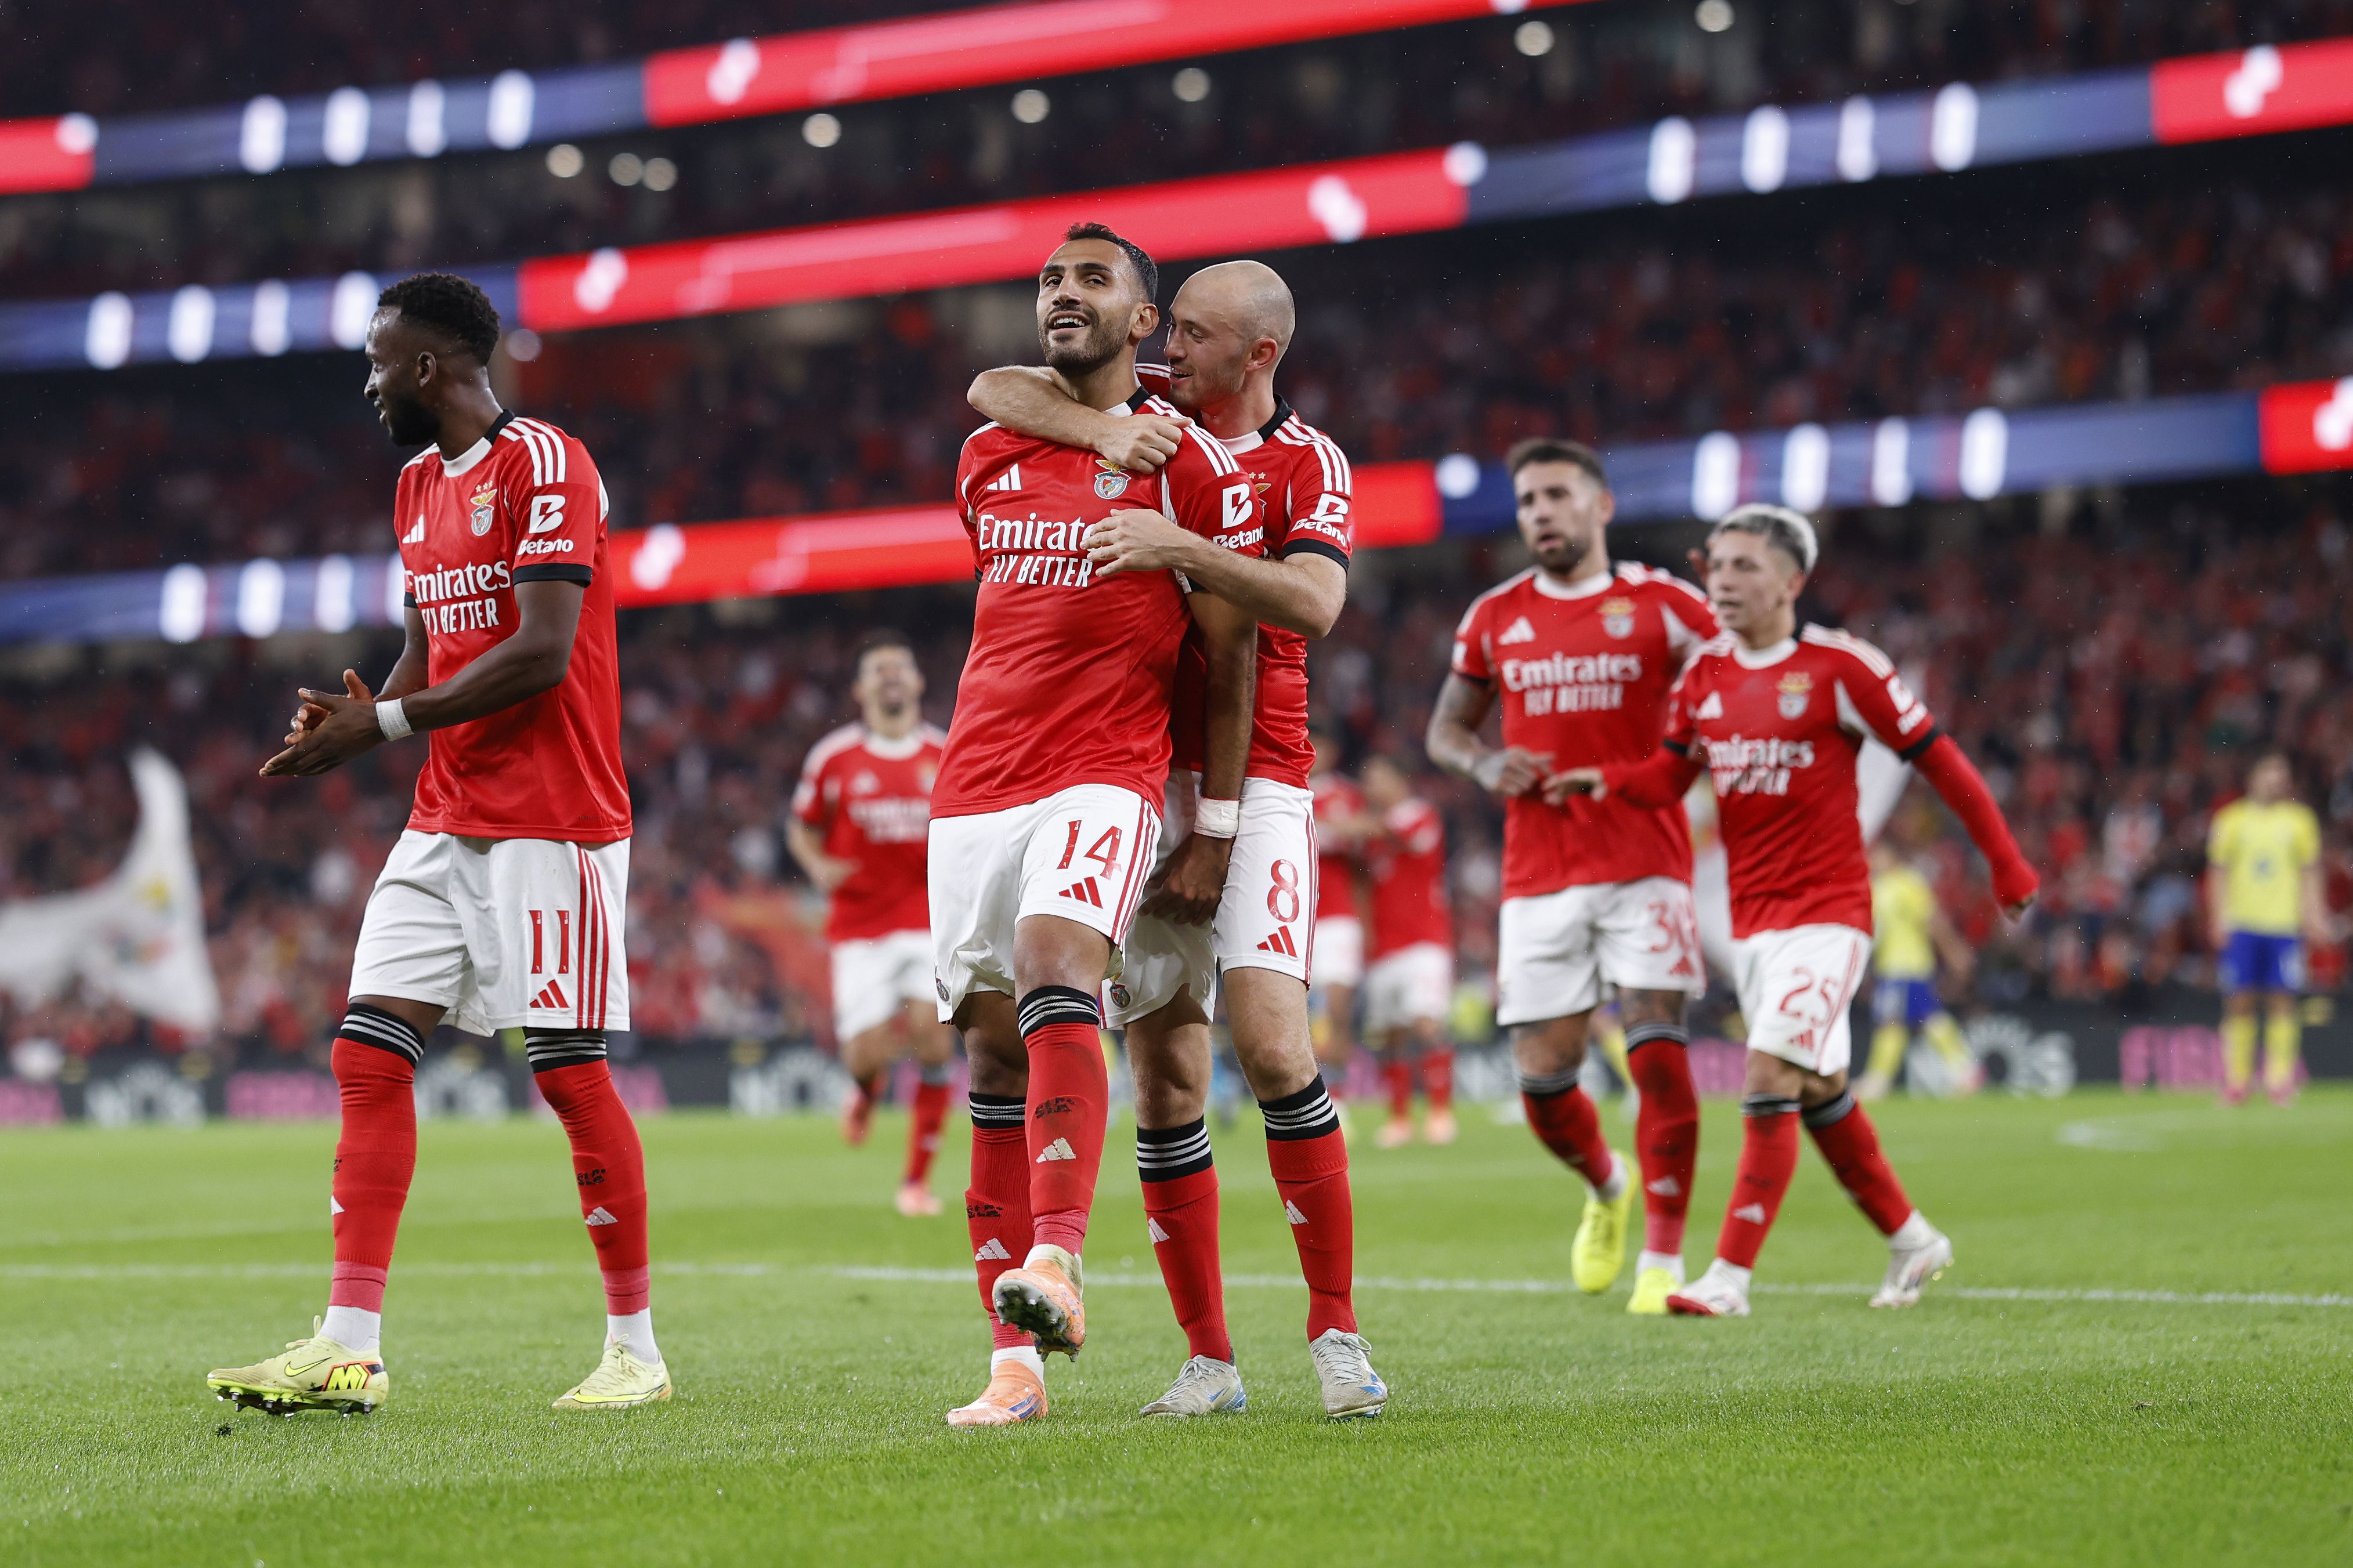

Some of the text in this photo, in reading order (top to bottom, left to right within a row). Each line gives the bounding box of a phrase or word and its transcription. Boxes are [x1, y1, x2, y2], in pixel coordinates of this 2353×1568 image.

[517, 538, 574, 556] Betano
[979, 512, 1103, 552] Emirat
[1213, 526, 1263, 549] Betano
[1290, 518, 1346, 547] Betano
[986, 555, 1093, 588] FLY BETTER
[439, 597, 499, 634] BETTER
[1502, 651, 1643, 693] Emirates
[1057, 819, 1122, 881] 14
[1267, 859, 1300, 924] 8
[527, 910, 570, 975] 11
